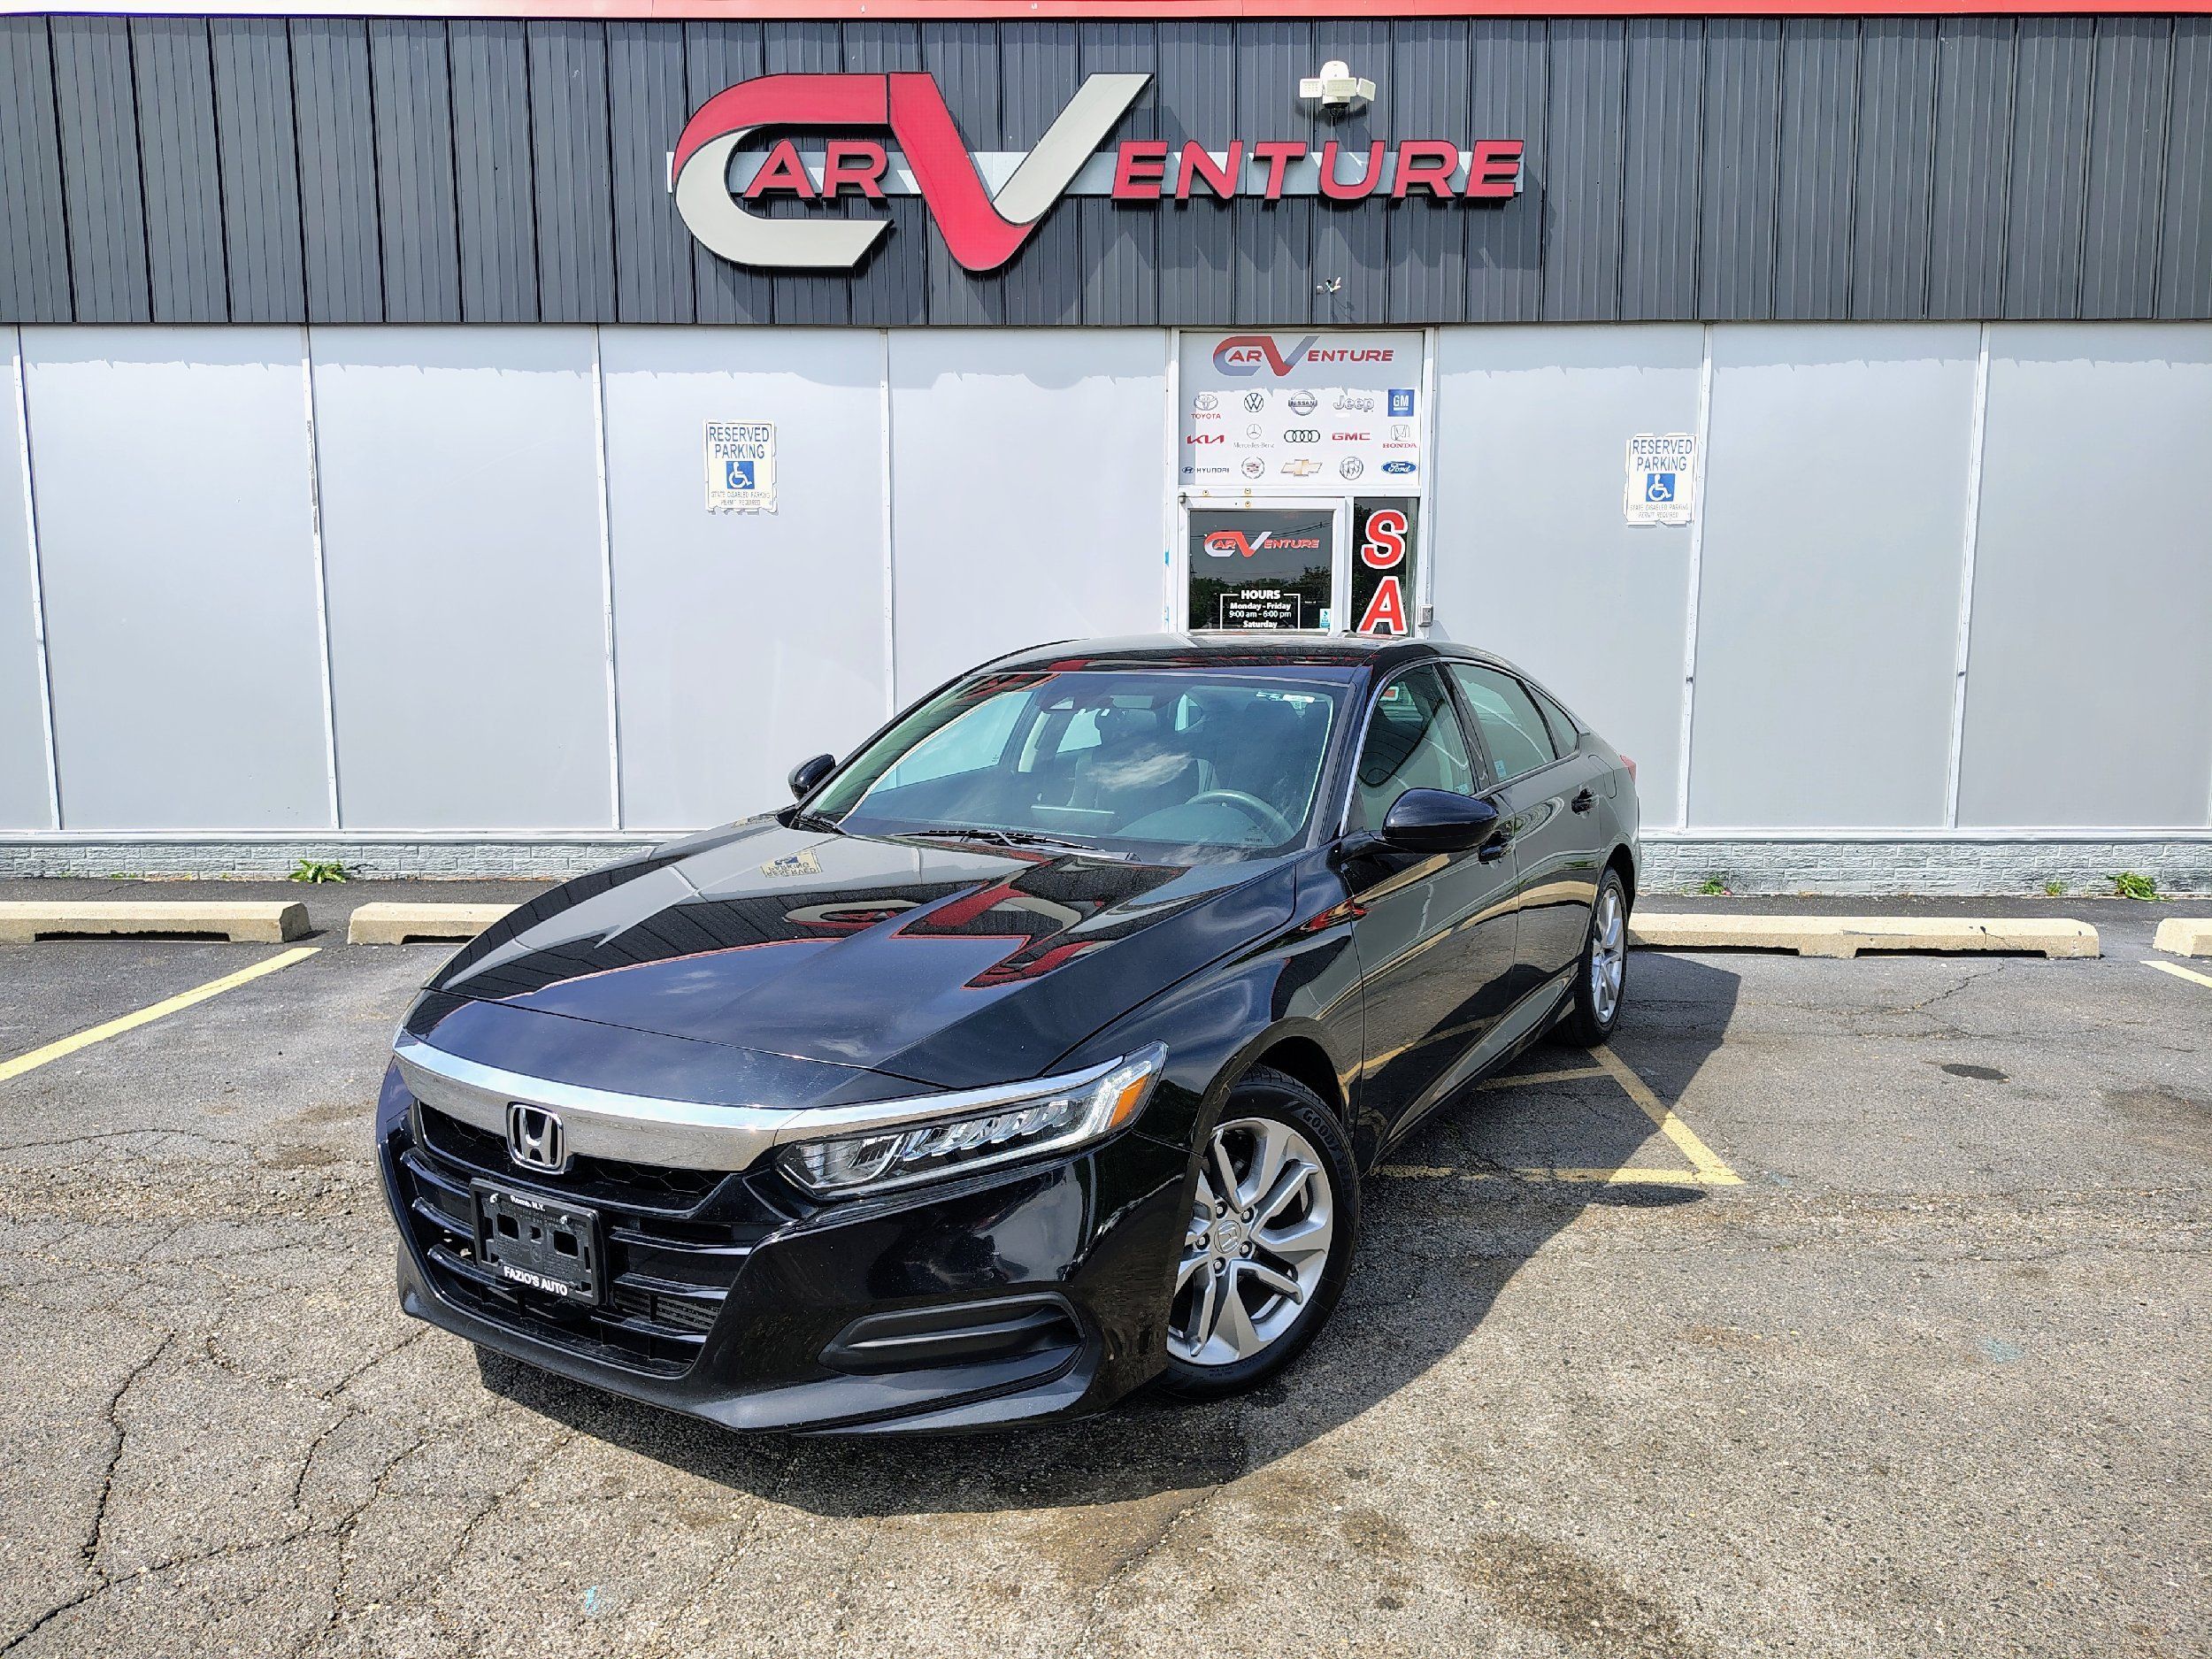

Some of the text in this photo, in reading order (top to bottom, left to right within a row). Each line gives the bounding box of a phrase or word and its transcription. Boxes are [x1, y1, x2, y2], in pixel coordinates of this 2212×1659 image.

[1333, 396, 1374, 412] Jeep
[1393, 396, 1409, 407] GM
[709, 426, 770, 442] RESERVED
[715, 444, 764, 459] PARKING
[1632, 440, 1693, 454] RESERVED
[1637, 457, 1687, 472] PARKING
[1241, 590, 1280, 599] HOURS
[1243, 620, 1278, 629] Saturday
[503, 1265, 568, 1296] FAZIO'S AUTO
